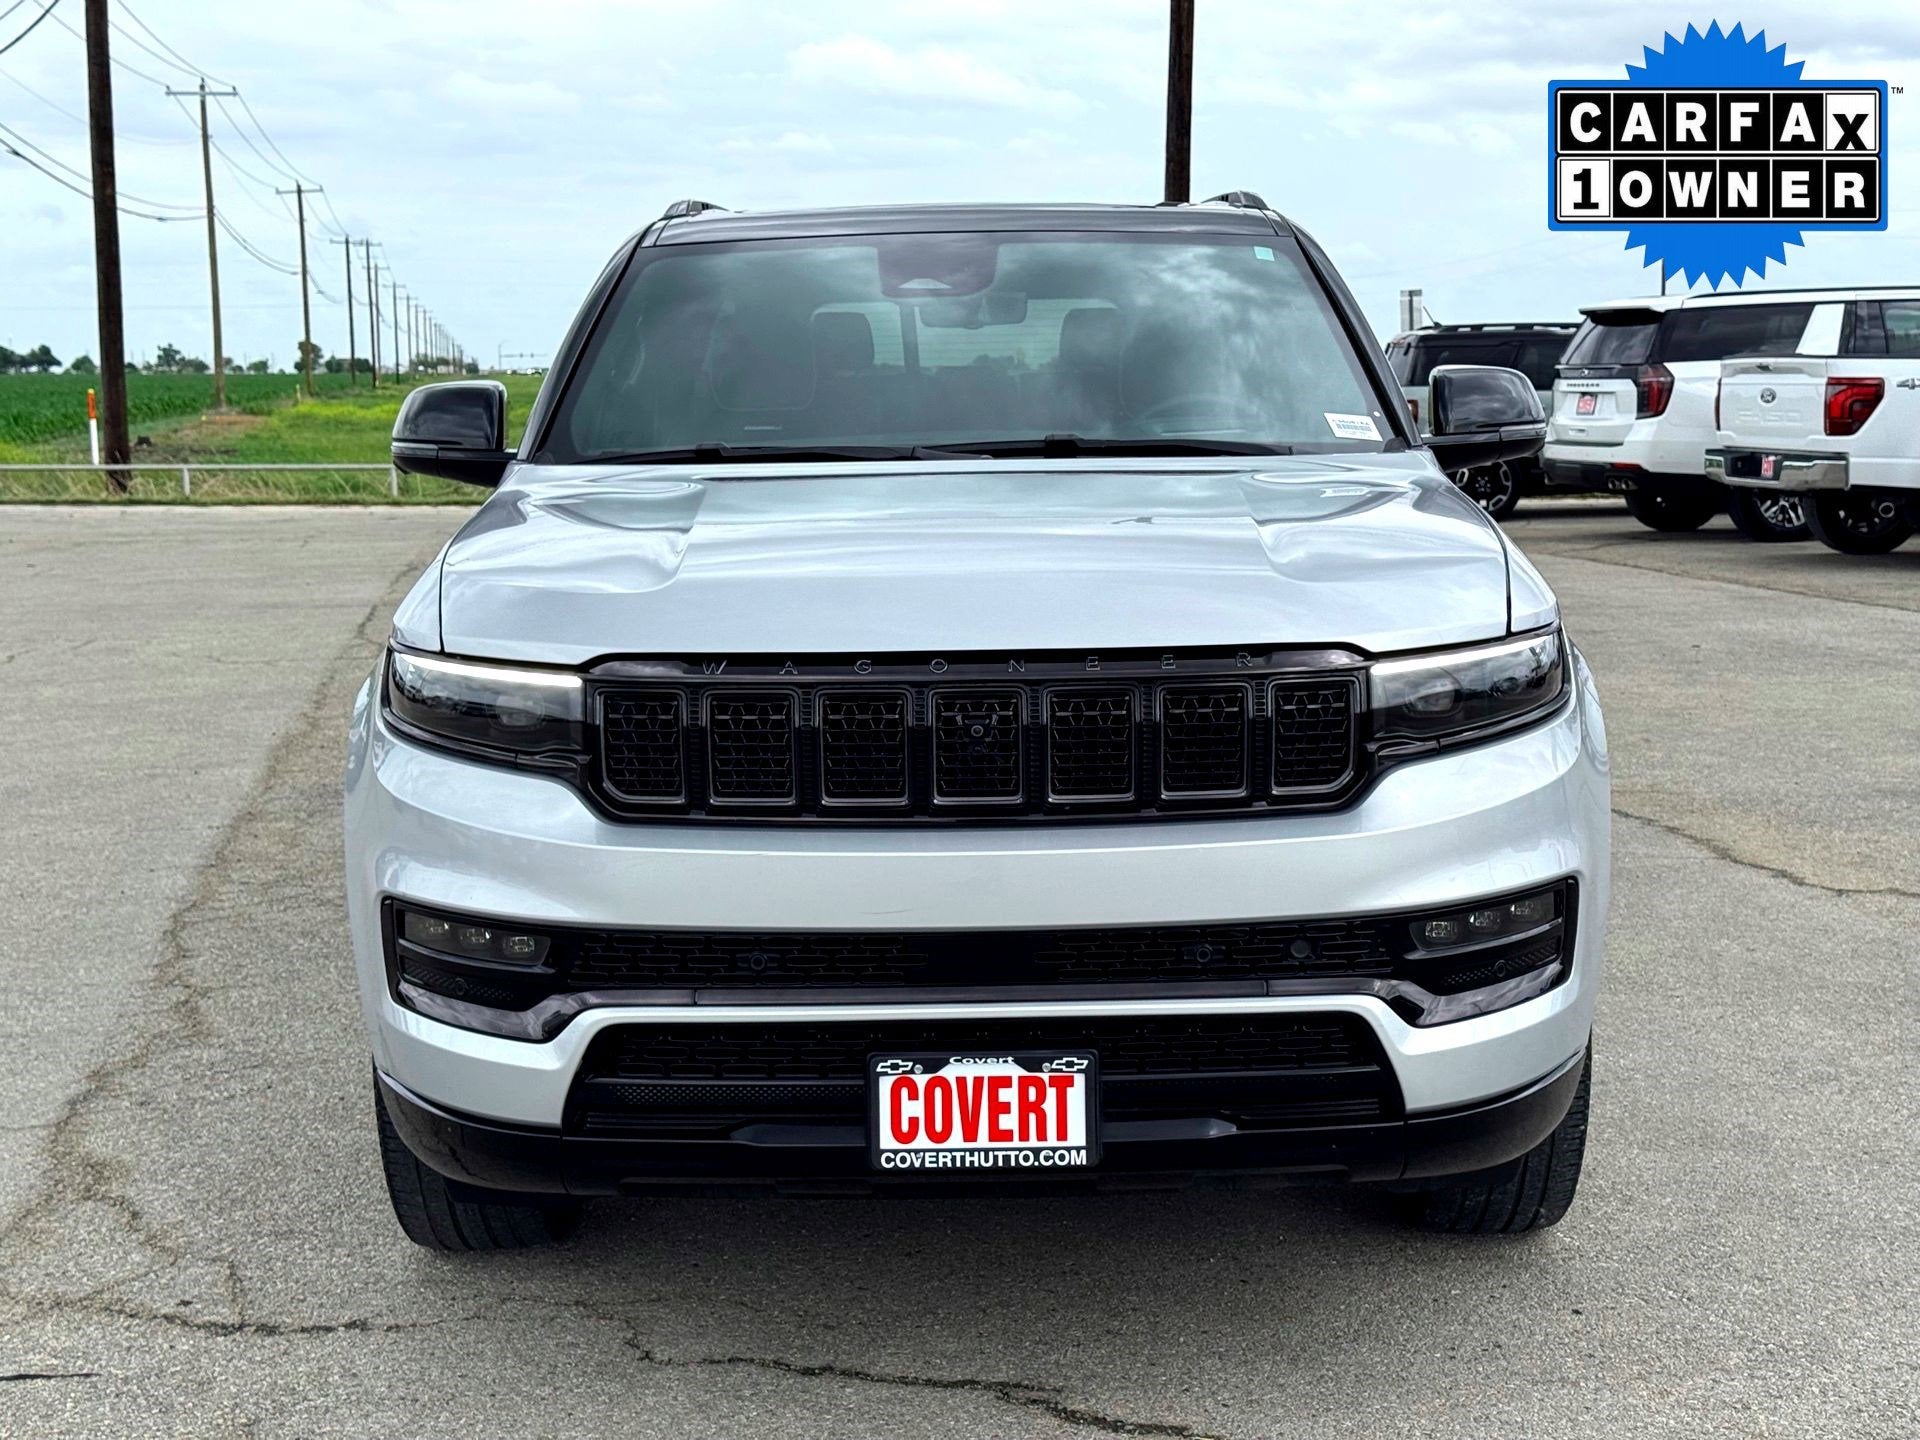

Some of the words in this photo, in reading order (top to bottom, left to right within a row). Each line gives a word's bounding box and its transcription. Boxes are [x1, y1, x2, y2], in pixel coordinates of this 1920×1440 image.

[702, 652, 1253, 674] WAGONEER
[949, 1056, 1014, 1065] Covert
[890, 1075, 1074, 1144] COVERT
[881, 1150, 1087, 1169] COVERTHUTTO.COM
